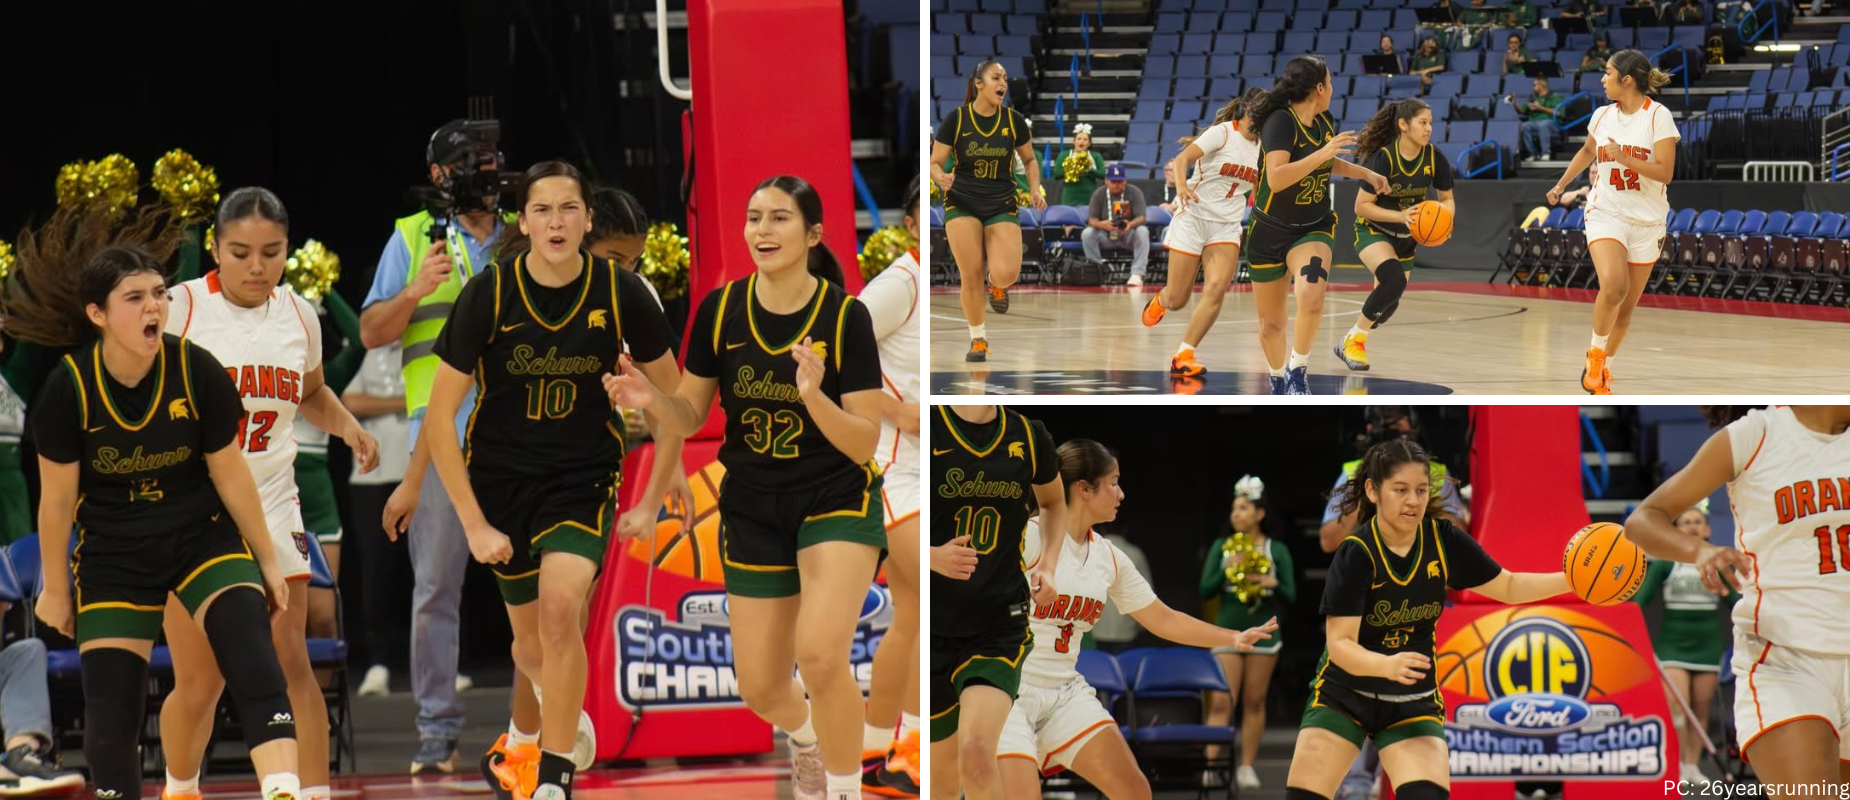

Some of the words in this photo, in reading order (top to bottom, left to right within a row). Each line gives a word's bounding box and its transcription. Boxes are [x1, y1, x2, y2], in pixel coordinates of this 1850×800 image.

[974, 160, 998, 179] 31
[1610, 168, 1640, 191] 42
[1295, 172, 1330, 205] 25
[506, 344, 602, 375] Schurr
[525, 378, 577, 420] 10
[741, 408, 803, 458] 32
[92, 444, 192, 474] Schurr
[938, 467, 1023, 498] Schurr
[954, 505, 1001, 555] 10
[1366, 599, 1442, 627] Schurr
[1498, 631, 1578, 697] CIF
[1504, 699, 1572, 727] Ford
[1557, 722, 1658, 755] Section
